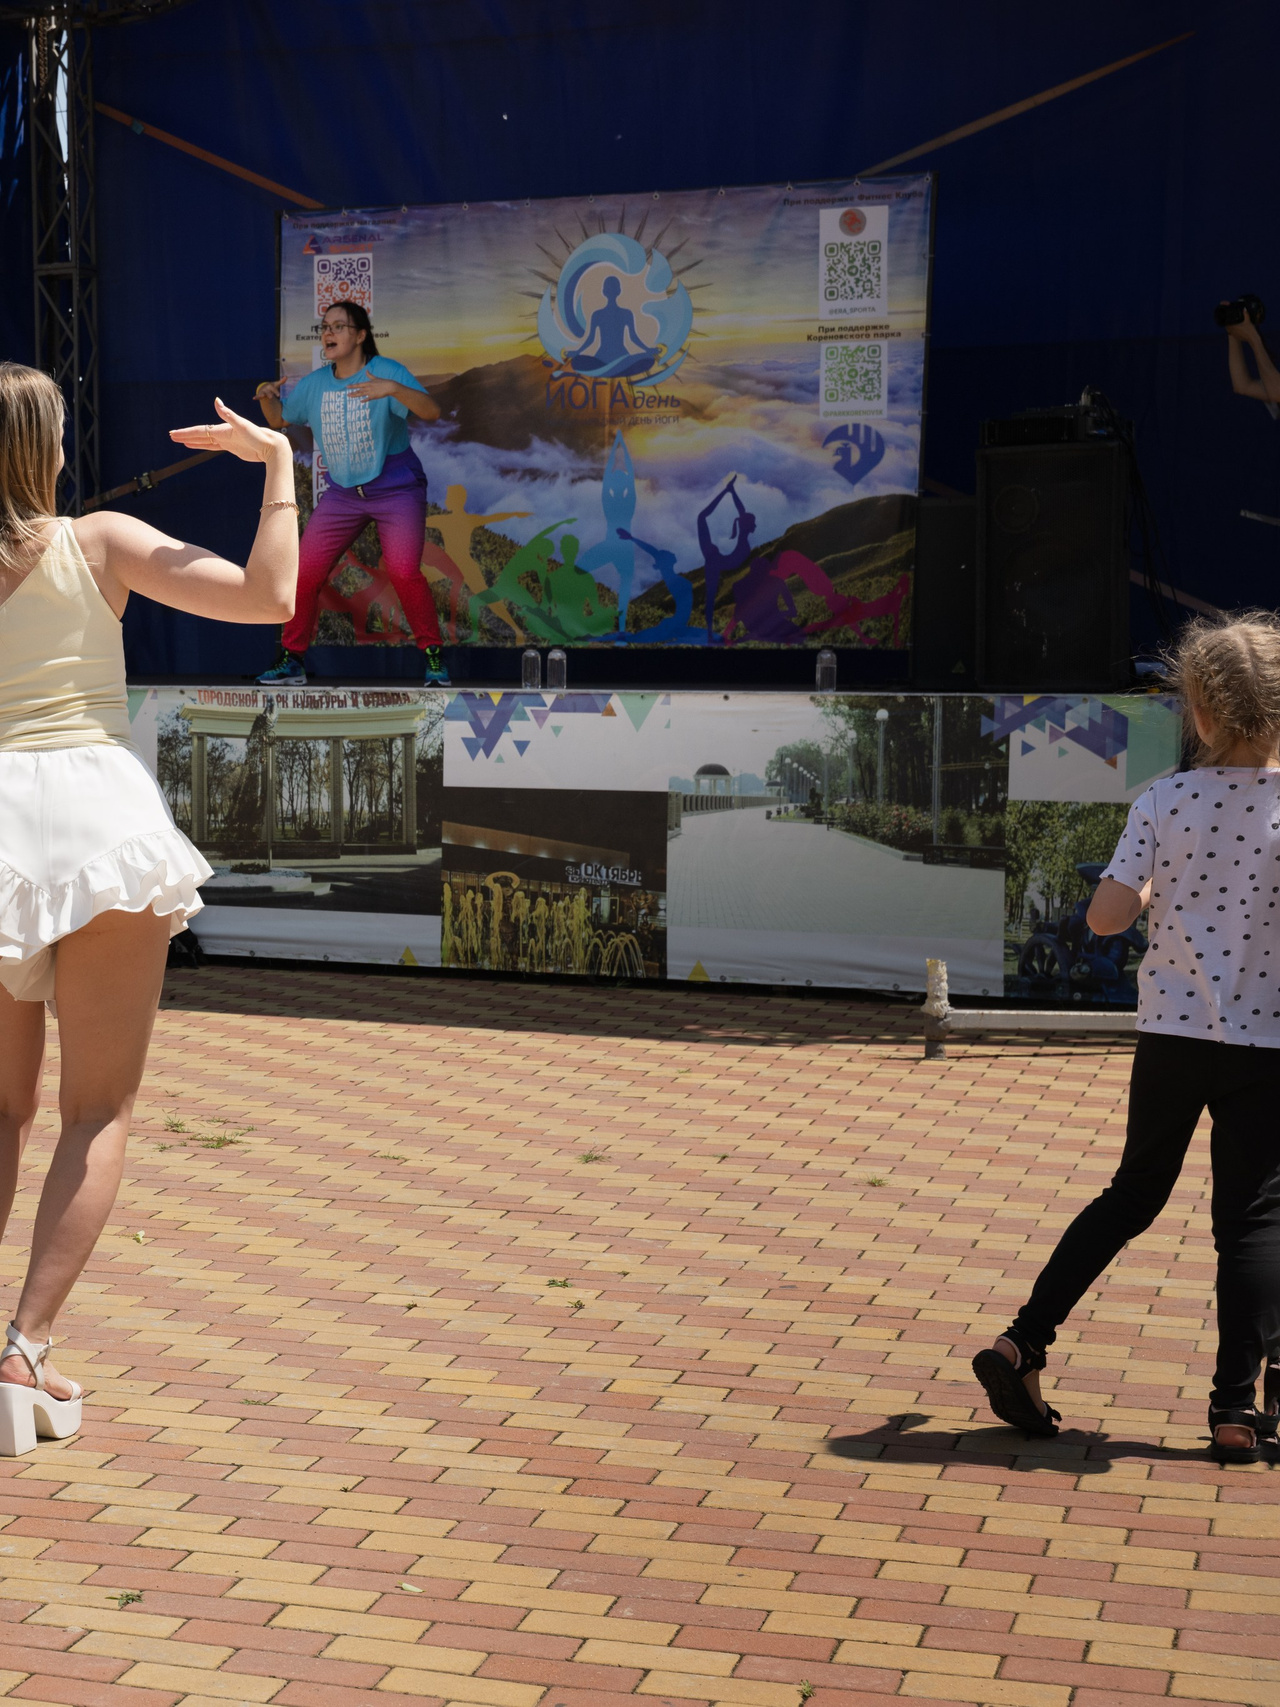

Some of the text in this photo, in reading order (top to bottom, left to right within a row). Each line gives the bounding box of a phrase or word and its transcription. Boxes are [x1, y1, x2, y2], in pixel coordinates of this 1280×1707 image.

[783, 198, 801, 206] При
[804, 196, 854, 206] поддержке
[857, 193, 891, 202] Фитнес
[322, 233, 385, 245] ARSENAL
[818, 324, 890, 334] При поддержке
[807, 331, 902, 342] Кореновского парка
[632, 390, 681, 409] день
[321, 409, 371, 423] DANCE HAPPY
[321, 420, 371, 434] DANCE HAPPY
[322, 432, 347, 444] DANCE
[197, 689, 258, 708] ГОРОДСКОЙ
[293, 692, 348, 709] КУЛЬТУРЫ
